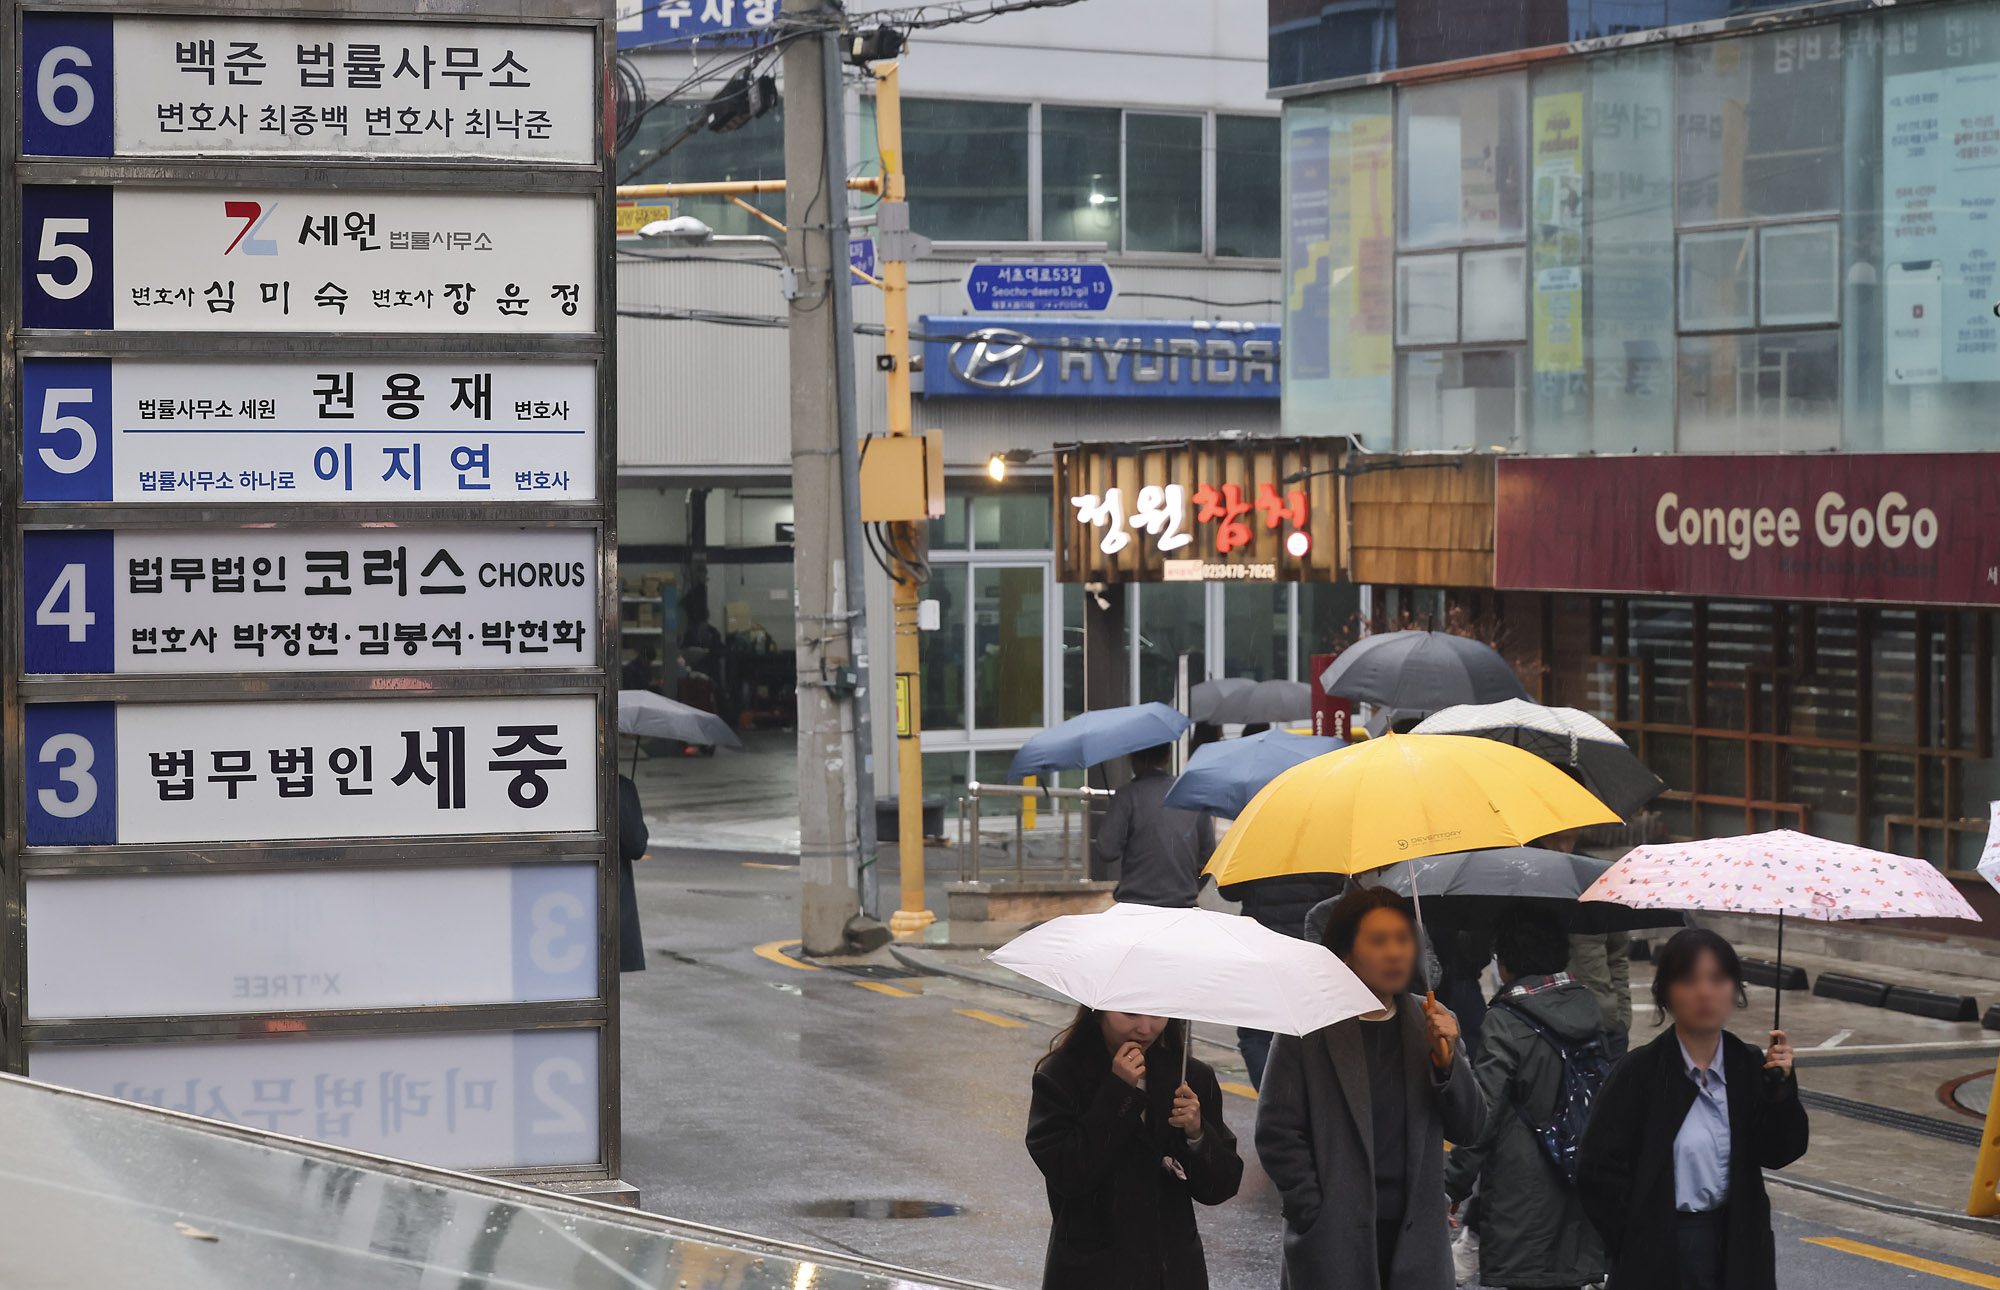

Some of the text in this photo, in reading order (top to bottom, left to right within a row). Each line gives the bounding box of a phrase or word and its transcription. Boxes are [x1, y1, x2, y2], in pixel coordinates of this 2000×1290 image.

[37, 46, 95, 126] 6
[175, 39, 531, 91] 백준 법률사무소
[157, 102, 553, 140] 변호사 최종백 변호사 최낙준
[298, 211, 493, 252] 세원 법률사무소
[37, 218, 93, 299] 5
[131, 286, 195, 308] 변호사
[371, 288, 434, 310] 변호사
[976, 281, 988, 293] 17
[1093, 281, 1105, 293] 13
[1058, 336, 1281, 383] HYUNDA
[38, 388, 97, 474] 5
[138, 398, 234, 420] 법률사무소
[238, 398, 276, 420] 세원
[514, 400, 570, 421] 변호사
[139, 470, 234, 492] 법률사무소
[239, 470, 296, 491] 하나로
[515, 470, 570, 491] 변호사
[1655, 491, 1939, 561] Congee GoGo
[129, 546, 585, 597] 법무법인 코러스 CHORUS
[36, 564, 96, 643] 4
[132, 626, 218, 655] 변호사
[37, 733, 98, 818] 3
[148, 724, 567, 810] 법무법인 세중
